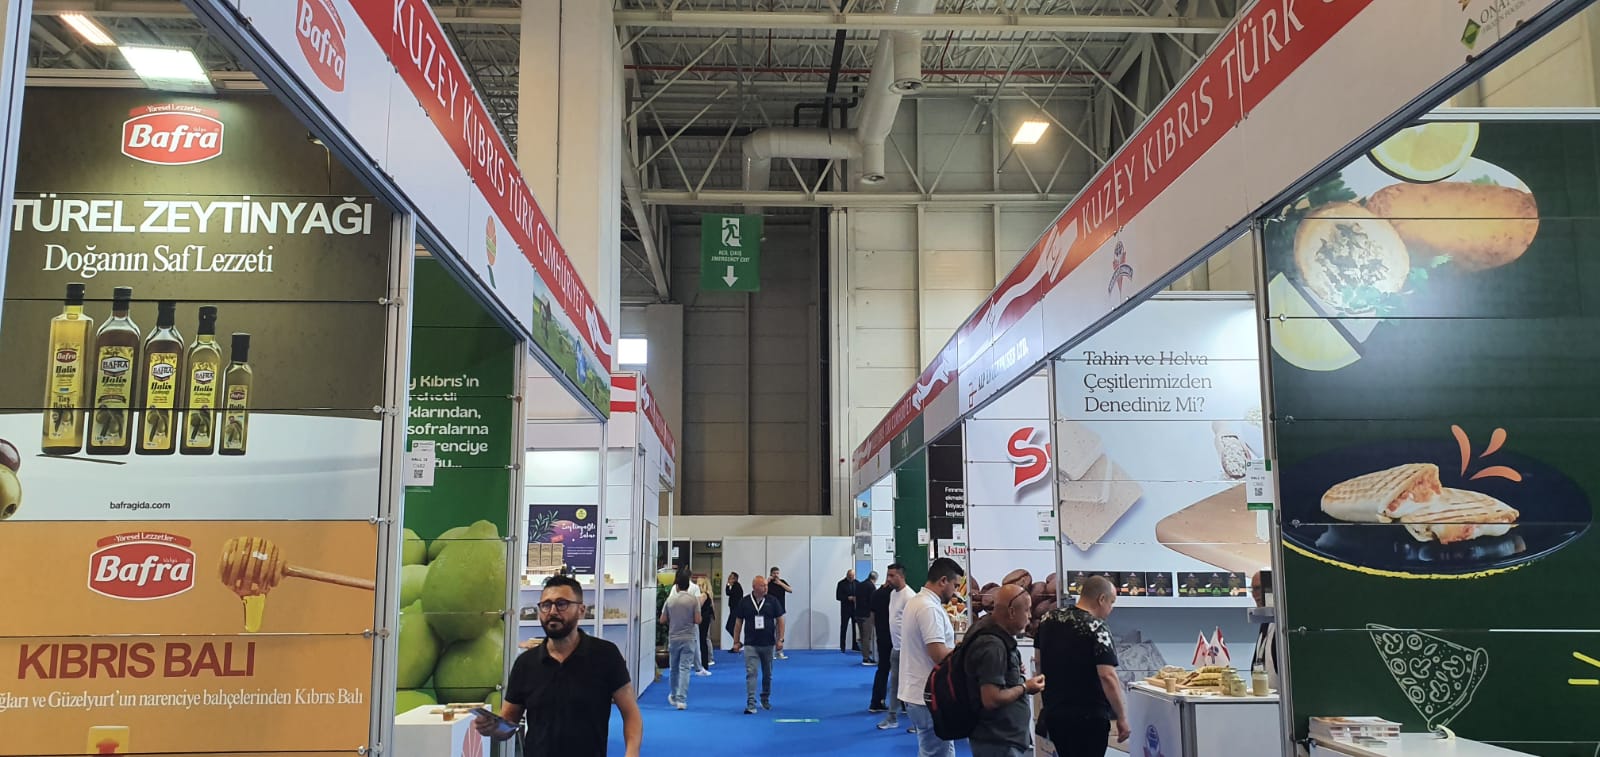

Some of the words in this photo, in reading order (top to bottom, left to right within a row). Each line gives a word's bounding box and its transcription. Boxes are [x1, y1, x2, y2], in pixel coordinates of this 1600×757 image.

[299, 0, 344, 80] Bafra
[1081, 155, 1136, 241] KUZEY
[1142, 75, 1214, 182] KIBRIS
[1221, 0, 1305, 100] TÜRK
[128, 124, 219, 152] Bafra
[392, 0, 459, 121] KUZEY
[463, 95, 505, 198] KIBRIS
[508, 171, 535, 246] TÜRK
[537, 222, 586, 322] CUMHURİYETİ
[139, 195, 372, 235] ZEYTİNYAĞI
[43, 244, 148, 278] Doğanın
[152, 245, 190, 271] Saf
[194, 245, 273, 273] Lezzeti
[1083, 350, 1129, 366] Tahin
[1134, 354, 1155, 366] ve
[1159, 350, 1209, 367] Helva
[420, 374, 480, 388] Kıbrıs'ın
[1083, 374, 1213, 394] Çeşitlerimizden
[1084, 397, 1172, 413] Denediniz
[1175, 397, 1206, 413] Mi?
[109, 500, 172, 512] bafragida.com
[95, 555, 190, 586] Bafra
[17, 643, 155, 679] KIBRIS
[163, 642, 255, 677] BALI
[32, 696, 46, 708] ve
[139, 689, 201, 710] narenciye
[203, 689, 291, 709] bahçelerinden
[295, 688, 335, 704] Kıbrıs
[338, 688, 363, 704] Balı
